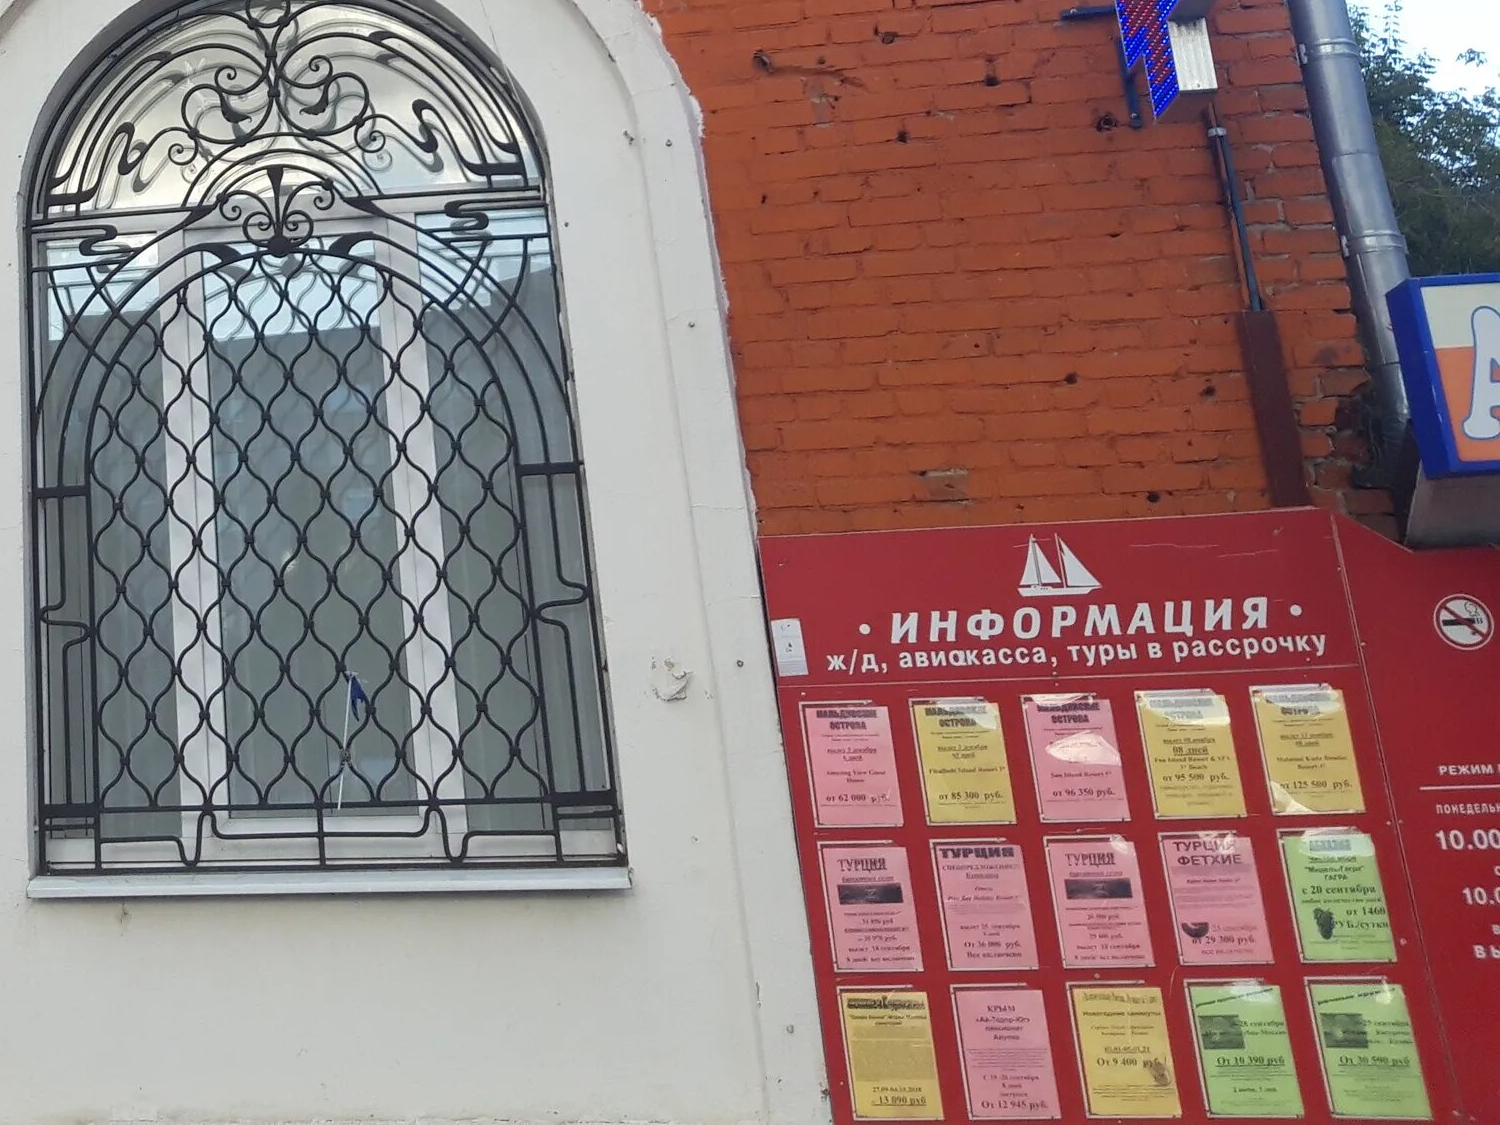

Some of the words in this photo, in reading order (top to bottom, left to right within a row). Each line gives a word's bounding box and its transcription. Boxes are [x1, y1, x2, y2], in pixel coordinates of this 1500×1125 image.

[890, 596, 1268, 644] ИНФОРМАЦИЯ
[826, 647, 888, 675] ж/д,
[899, 643, 1058, 669] авиакасса,
[1068, 639, 1138, 667] туры
[1147, 642, 1163, 659] в
[1173, 632, 1327, 665] рассрочку
[1439, 764, 1494, 775] РЕЖИМ
[939, 847, 1014, 859] ТУРЦИЯ
[1065, 852, 1116, 867] ТУРЦИЯ
[1177, 854, 1242, 865] ФЕТХИЕ
[837, 858, 887, 872] ТУРЦИЯ
